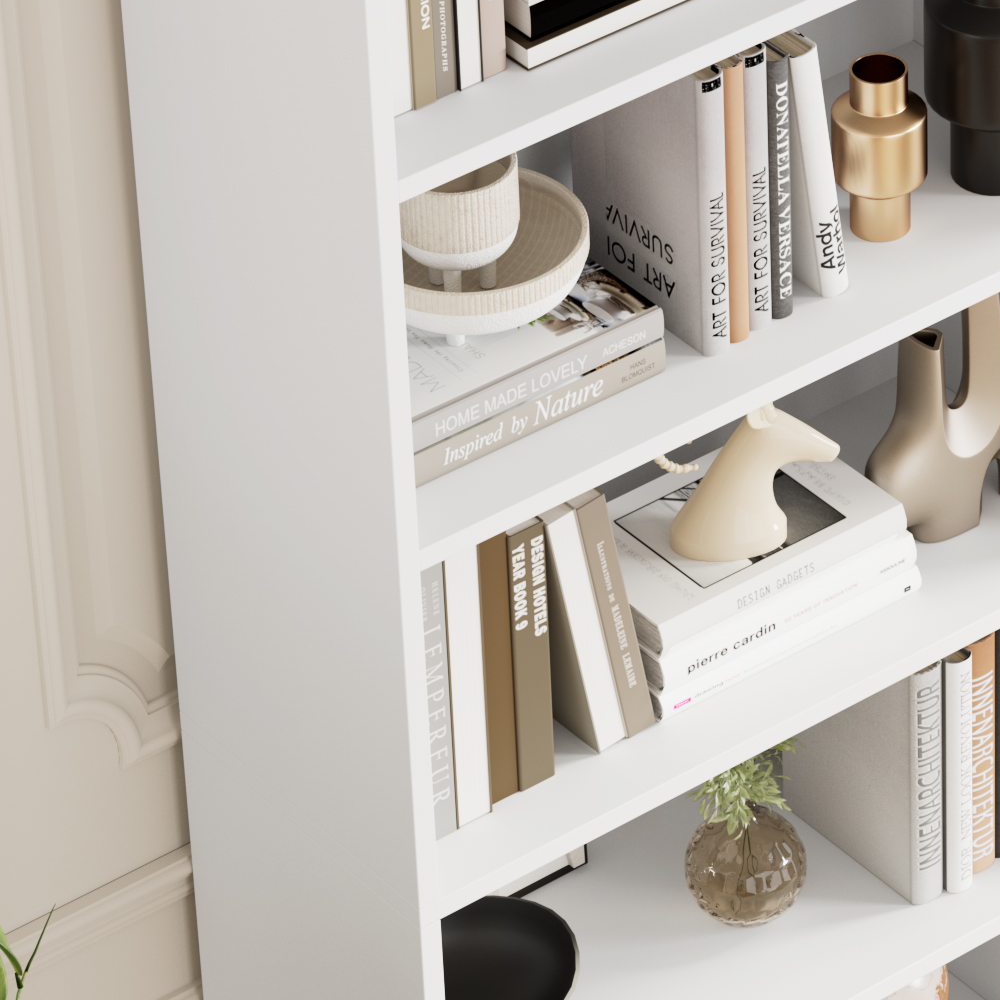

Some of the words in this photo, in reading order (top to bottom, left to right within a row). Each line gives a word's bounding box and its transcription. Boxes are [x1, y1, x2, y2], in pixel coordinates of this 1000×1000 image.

[439, 0, 449, 72] PHOTOGRAPHS
[775, 81, 790, 206] DONATELLA
[709, 192, 725, 268] SURVIVAL
[752, 166, 768, 242] SURVIVAL
[753, 244, 768, 280] FOR
[778, 208, 793, 300] VERSACE
[816, 222, 836, 269] Andy
[829, 204, 846, 274] Warhol
[643, 263, 675, 298] ART
[711, 269, 726, 305] FOR
[754, 285, 769, 312] ART
[712, 311, 727, 338] ART
[434, 405, 481, 437] HOME
[484, 383, 528, 415] MADE
[531, 355, 588, 393] LOVELY
[602, 329, 647, 358] ACHESON
[621, 361, 656, 384] BLOMQUIST
[629, 357, 647, 371] HANS
[443, 423, 504, 467] Inspired
[511, 415, 529, 435] by
[533, 378, 605, 426] Nature
[511, 543, 526, 582] YEAR
[530, 534, 546, 587] DESIGN
[736, 584, 771, 610] DESIGN
[776, 562, 816, 590] GADGETS
[513, 581, 529, 622] BOOK
[515, 619, 529, 631] 9
[533, 585, 548, 637] HOTELS
[610, 604, 629, 651] MADELEINE
[622, 652, 637, 689] LEMAIRE
[687, 646, 728, 675] pierre
[732, 621, 777, 650] cardin
[960, 670, 972, 766] REVOLUTION
[916, 679, 941, 872] INNENARCHITEKTUR
[960, 768, 972, 807] LOOK
[972, 669, 994, 862] INNENARCHITEKTUR
[961, 812, 972, 842] NEW
